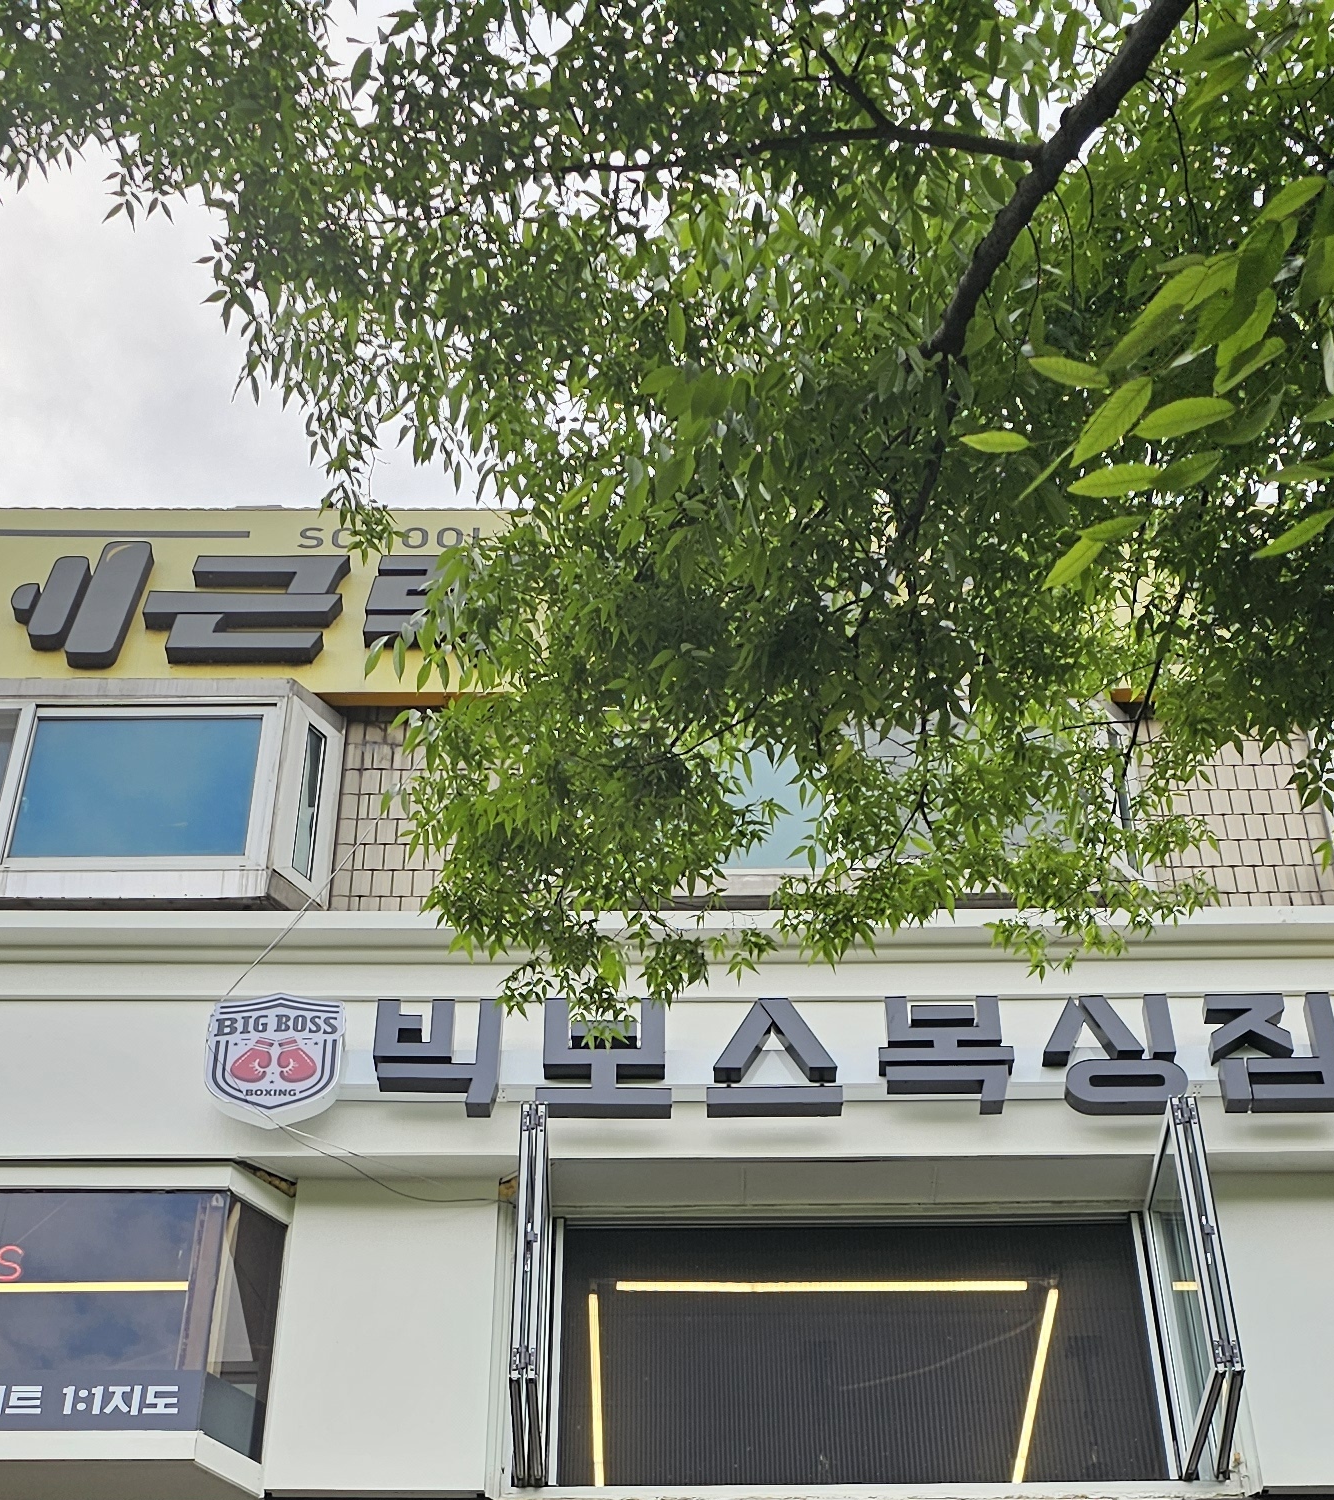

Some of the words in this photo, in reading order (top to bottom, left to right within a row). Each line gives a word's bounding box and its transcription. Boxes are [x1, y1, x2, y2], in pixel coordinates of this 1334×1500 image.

[297, 527, 483, 548] SCOO
[214, 1015, 269, 1037] BIG
[274, 1014, 338, 1034] BOSS
[245, 1088, 297, 1096] BOXING
[63, 1385, 178, 1416] 1:1지도
